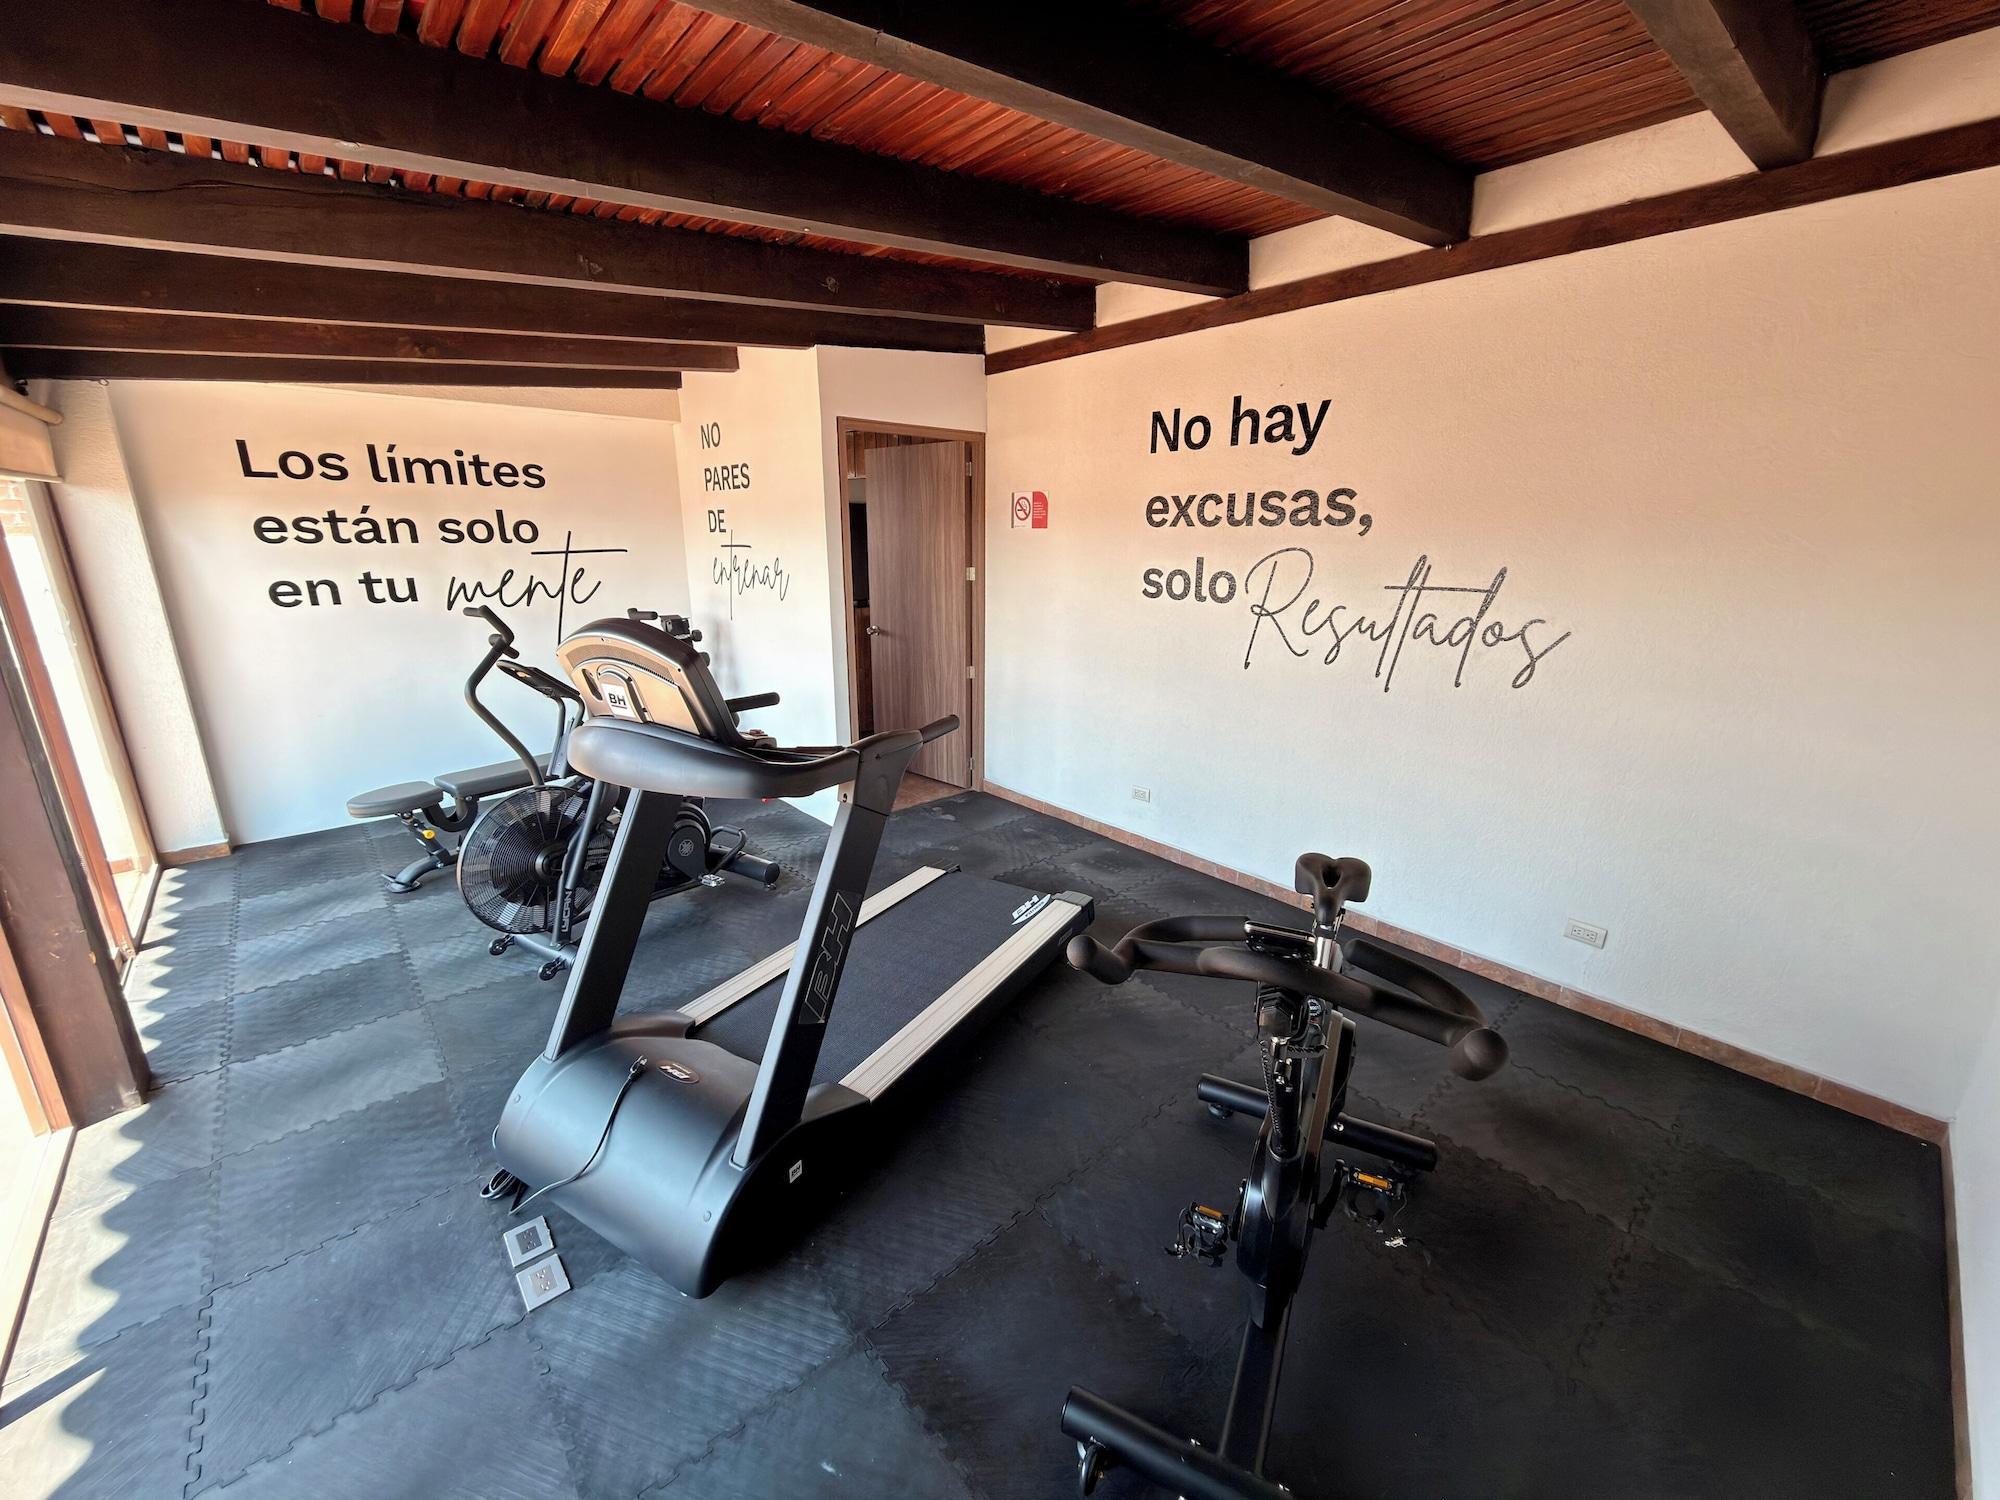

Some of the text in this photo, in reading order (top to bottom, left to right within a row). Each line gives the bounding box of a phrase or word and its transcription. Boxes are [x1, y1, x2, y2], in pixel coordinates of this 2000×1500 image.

[700, 421, 721, 449] NO
[1150, 395, 1332, 456] No hay
[235, 439, 546, 489] Los límites
[704, 462, 751, 492] PARES
[253, 505, 539, 545] están solo
[707, 509, 727, 533] DE
[1145, 487, 1374, 537] excusas,
[268, 530, 628, 644] en tu mente
[712, 529, 790, 620] entrenar
[1141, 546, 1572, 693] solo Resultados
[608, 693, 627, 706] BH
